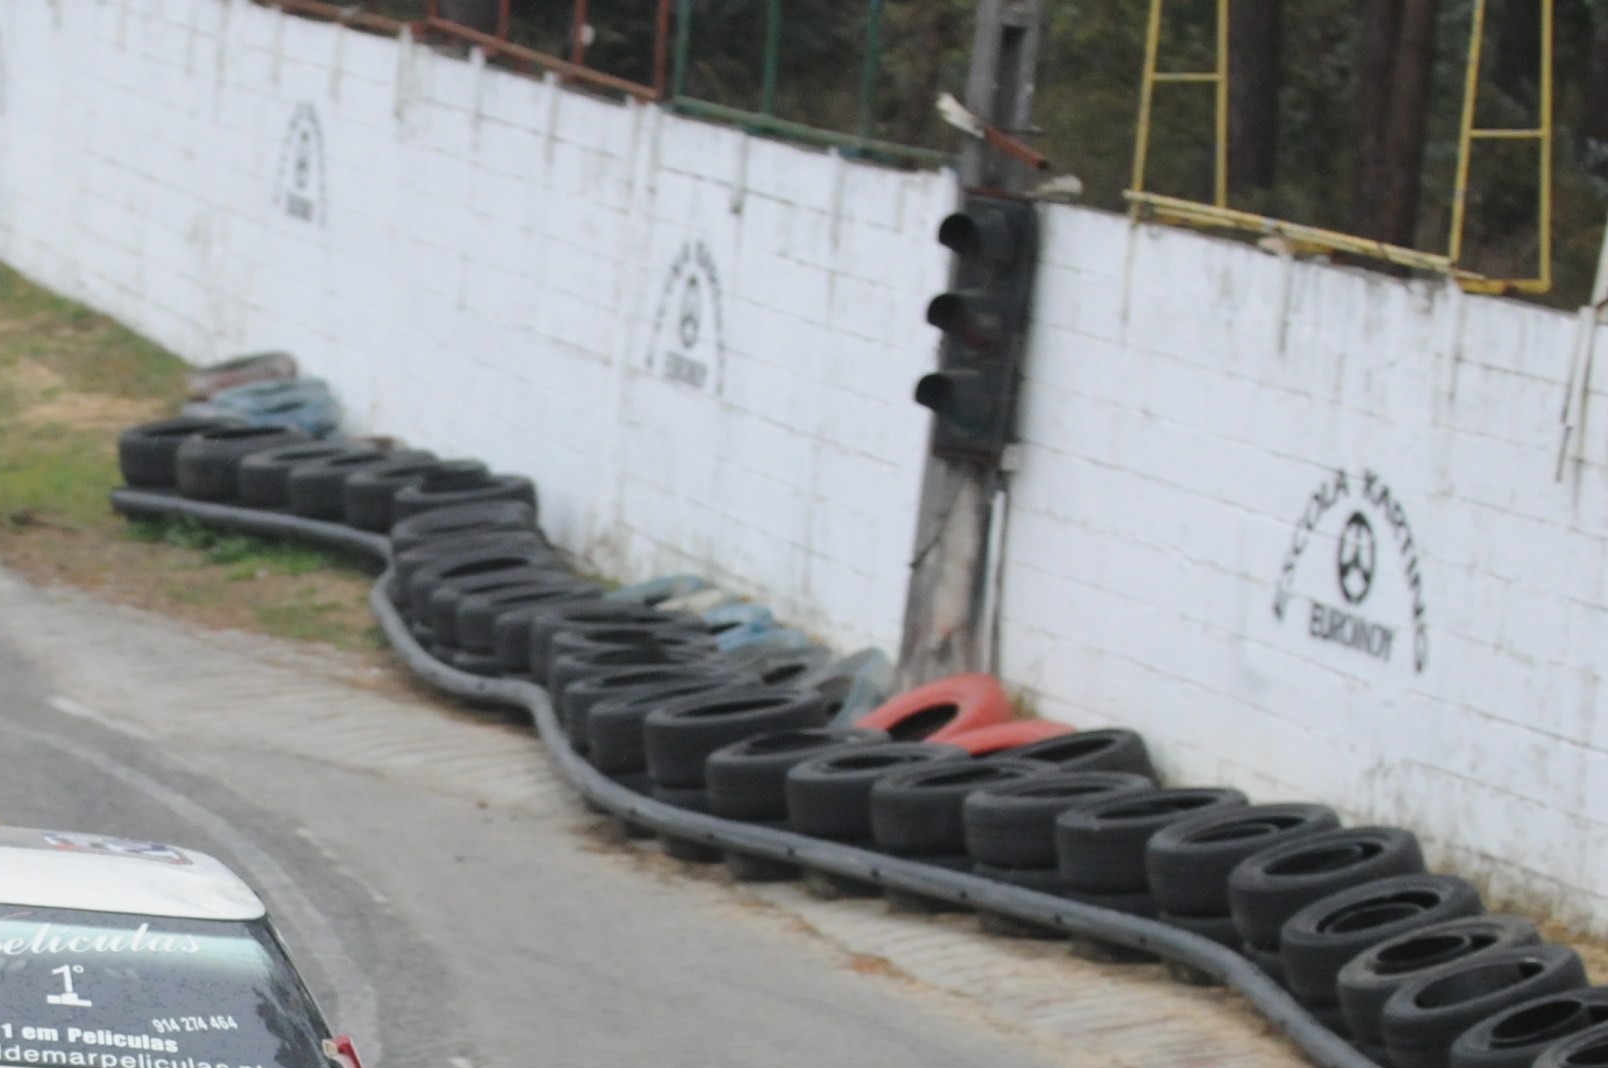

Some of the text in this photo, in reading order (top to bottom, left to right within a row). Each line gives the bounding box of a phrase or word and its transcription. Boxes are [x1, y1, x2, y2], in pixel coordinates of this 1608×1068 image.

[152, 1014, 238, 1034] 914 274 464
[1, 1023, 13, 1038] 1
[21, 1026, 59, 1041] em
[67, 1027, 179, 1053] Peliculas
